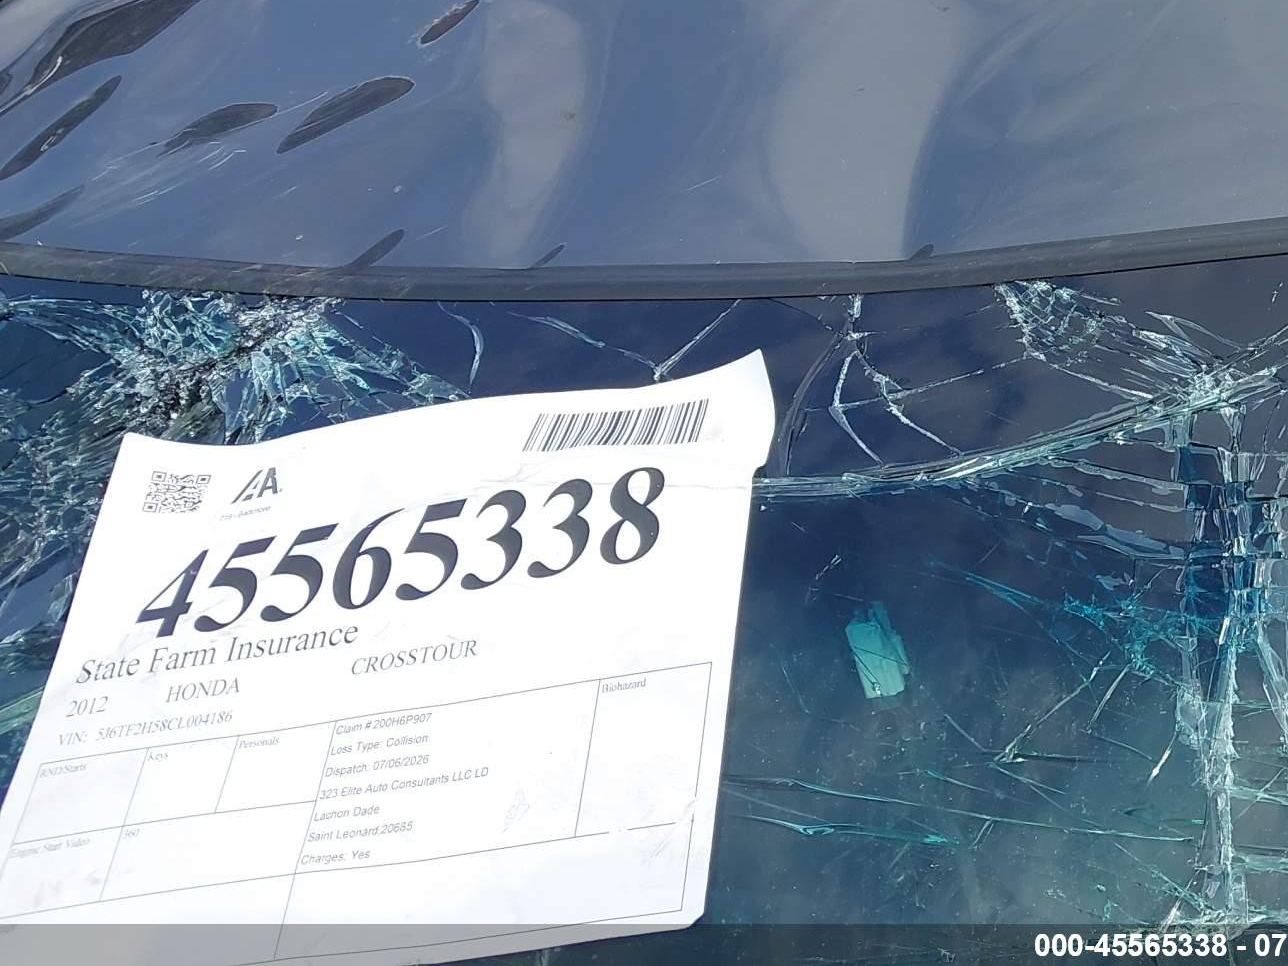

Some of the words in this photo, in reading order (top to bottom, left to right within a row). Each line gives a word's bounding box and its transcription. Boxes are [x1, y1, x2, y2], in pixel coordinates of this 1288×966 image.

[136, 466, 666, 638] 45565338
[76, 655, 140, 684] State
[148, 646, 216, 674] Farm
[224, 625, 359, 663] Insurance
[65, 696, 109, 718] 2012
[165, 677, 240, 703] HONDA
[351, 639, 478, 676] CROSSTOUR
[601, 677, 647, 694] Biohazard
[335, 723, 363, 736] Claim
[58, 732, 88, 747] VIN:
[238, 735, 280, 750] Personals
[330, 745, 353, 756] Loss
[356, 740, 383, 754] Type:
[386, 734, 429, 748] Collision
[148, 750, 169, 762] Keys
[325, 763, 370, 778] Dispatch:
[319, 789, 338, 801] 323
[340, 785, 362, 797] Elite
[364, 782, 389, 795] Auto
[391, 774, 450, 791] Consultants
[452, 769, 472, 782] LLC
[353, 804, 381, 817] Dade
[307, 830, 333, 843] Saint
[301, 852, 347, 866] Charges:
[352, 849, 371, 860] Yes
